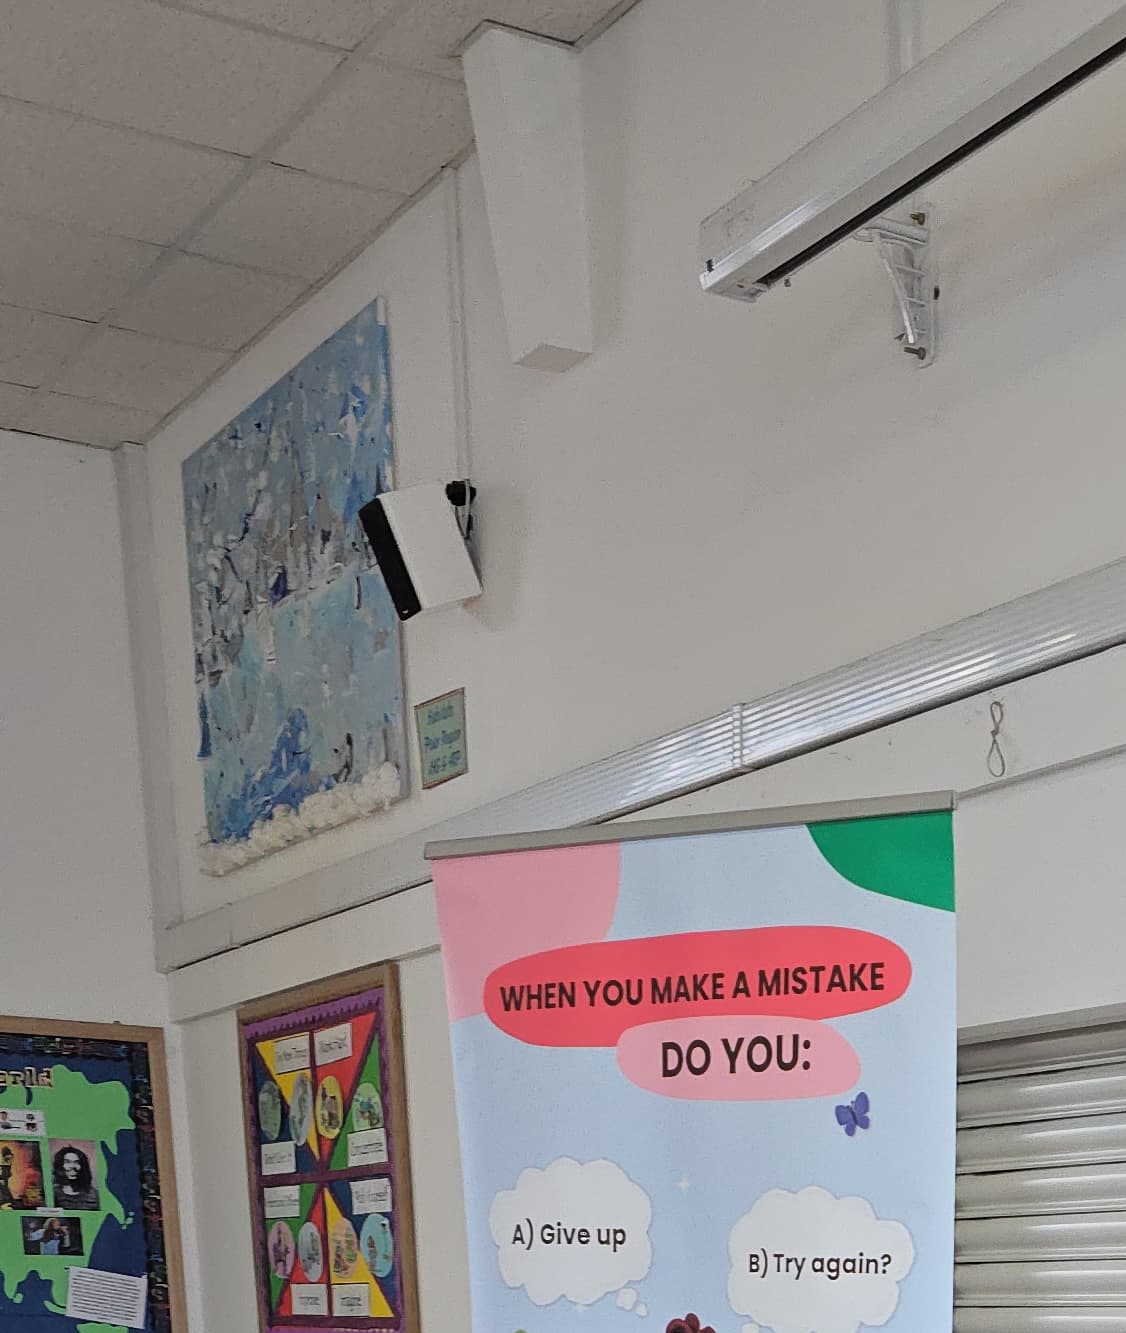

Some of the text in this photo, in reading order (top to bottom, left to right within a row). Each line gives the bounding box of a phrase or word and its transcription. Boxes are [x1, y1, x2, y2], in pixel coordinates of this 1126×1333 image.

[500, 962, 885, 1012] WHEN YOU MAKE A MISTAKE
[661, 1033, 811, 1078] DO YOU:
[511, 1217, 627, 1253] A) Give up
[749, 1247, 892, 1281] B) Try again?
